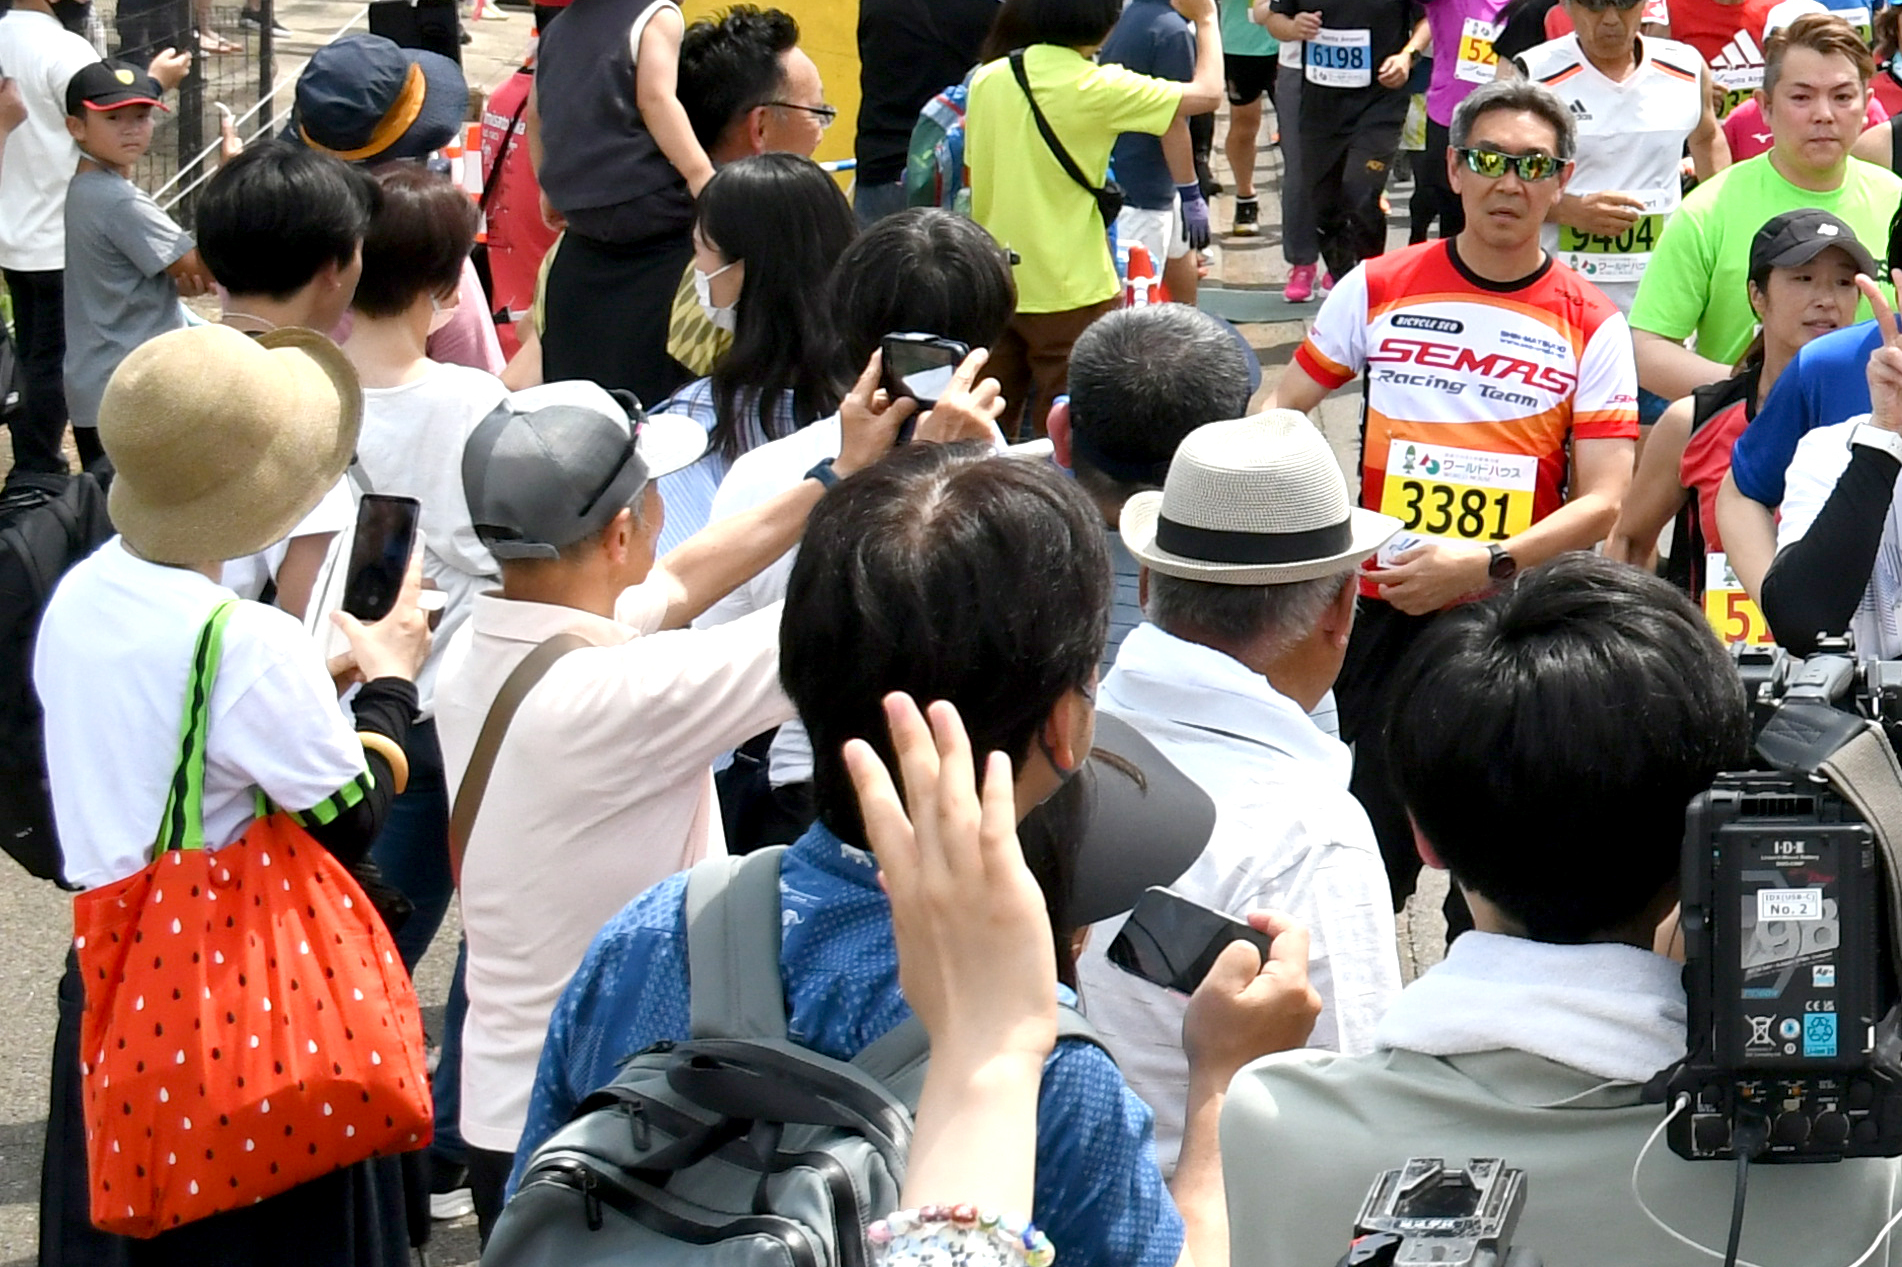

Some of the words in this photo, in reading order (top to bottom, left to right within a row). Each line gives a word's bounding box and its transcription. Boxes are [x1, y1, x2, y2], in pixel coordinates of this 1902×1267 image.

[1312, 44, 1364, 70] 6198
[1467, 38, 1500, 65] 52
[1396, 316, 1435, 329] BICYCLE
[1367, 337, 1578, 395] SEMAS
[1378, 369, 1468, 395] Racing
[1478, 383, 1539, 409] Team
[1443, 459, 1521, 479] ワールドハウス
[1402, 480, 1511, 541] 3381
[1724, 592, 1776, 643] 5
[1799, 903, 1808, 914] 2
